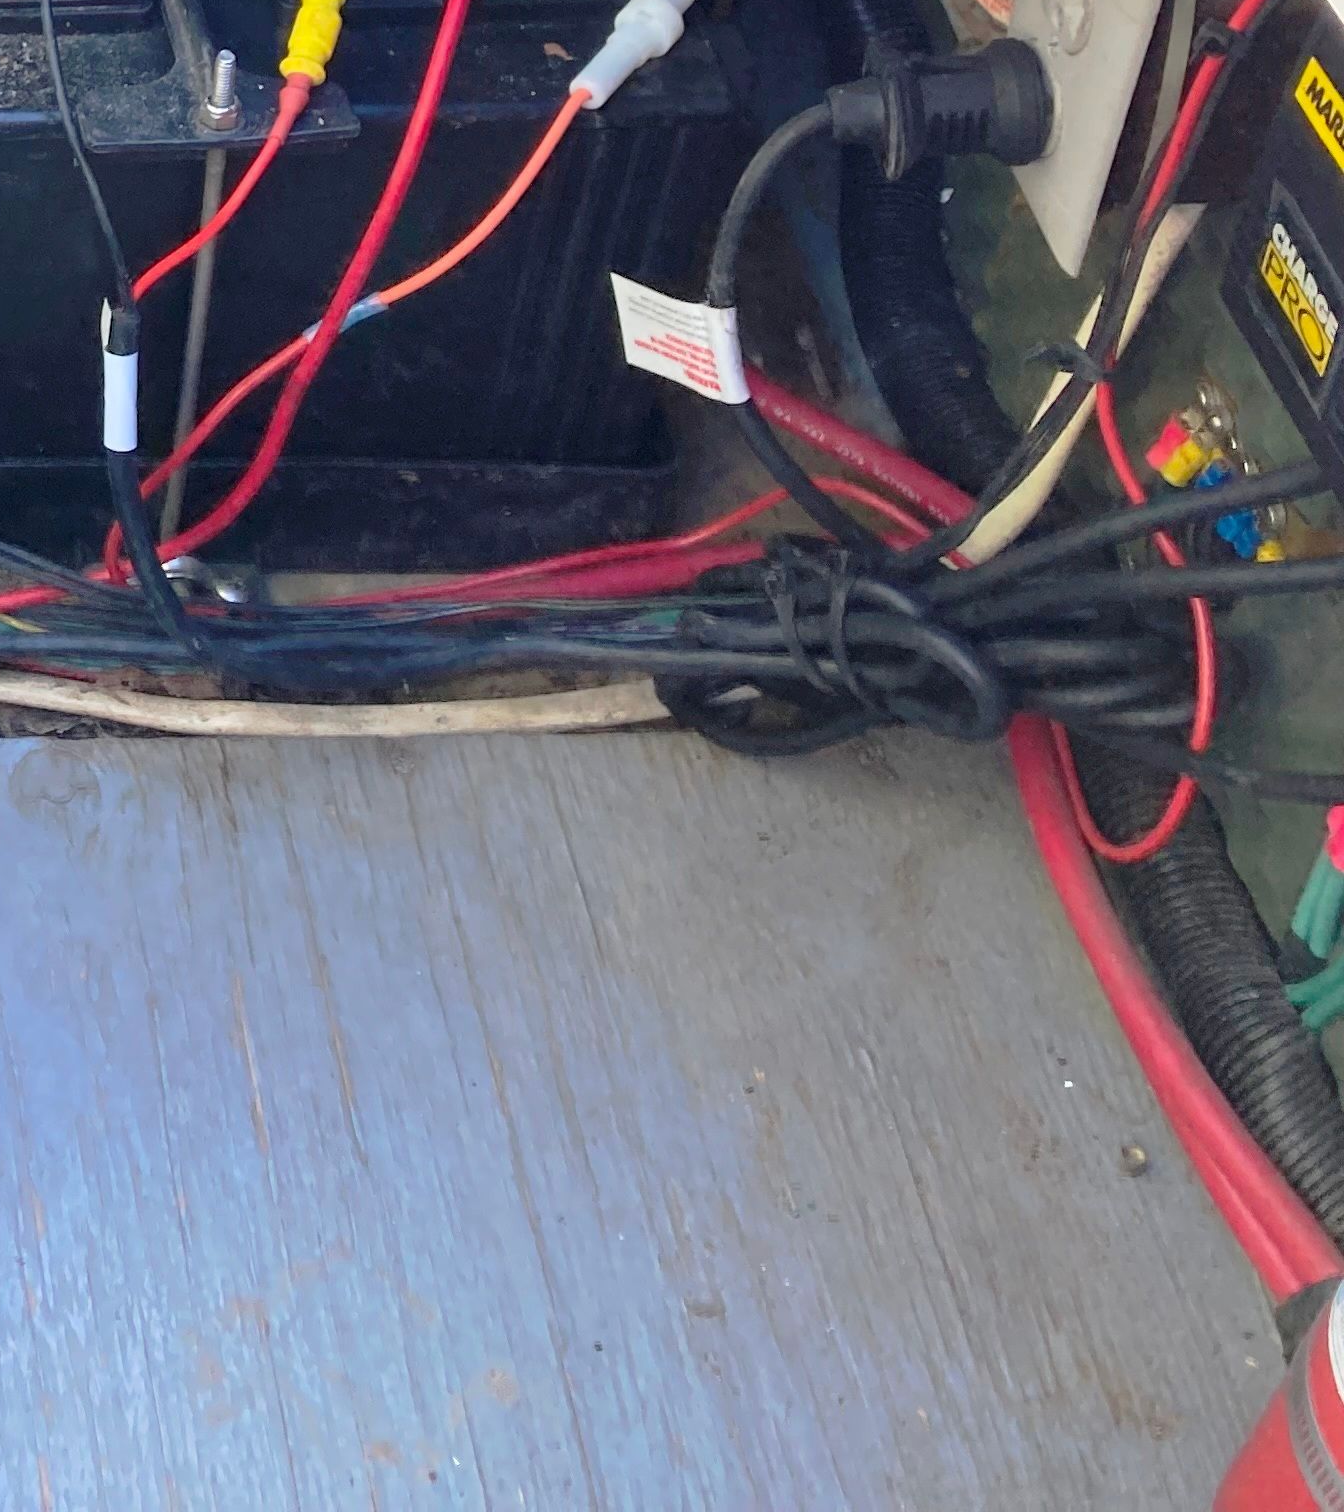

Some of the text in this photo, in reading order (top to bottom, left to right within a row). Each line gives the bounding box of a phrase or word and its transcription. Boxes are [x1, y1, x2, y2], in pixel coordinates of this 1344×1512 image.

[1305, 76, 1344, 152] MAR
[1263, 253, 1331, 361] PRO
[1271, 222, 1339, 338] CHARGE
